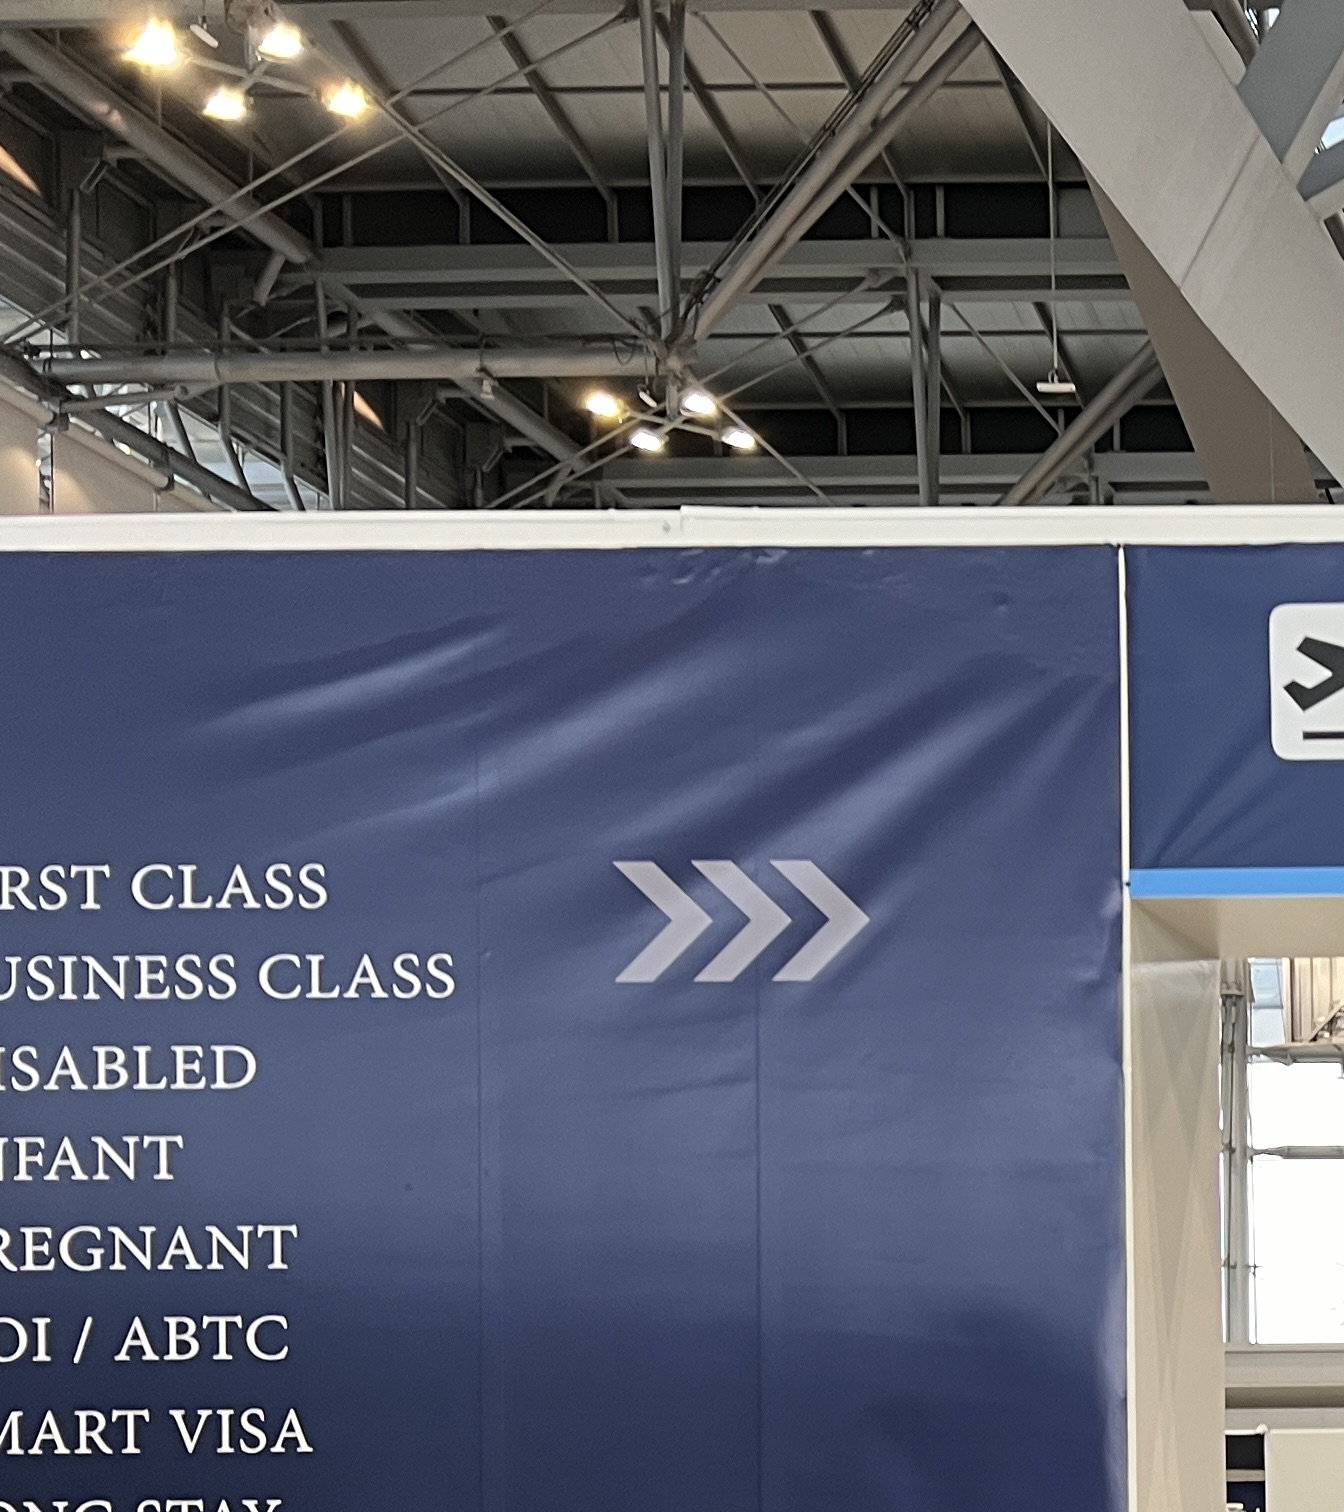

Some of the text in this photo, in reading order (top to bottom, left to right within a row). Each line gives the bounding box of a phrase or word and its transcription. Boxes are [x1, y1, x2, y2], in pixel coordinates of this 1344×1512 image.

[131, 863, 328, 910] CLASS
[258, 953, 455, 1000] CLASS
[0, 1045, 257, 1092] SABLED
[73, 1316, 93, 1364] /
[114, 1314, 289, 1361] ABTC
[168, 1408, 314, 1455] VISA
